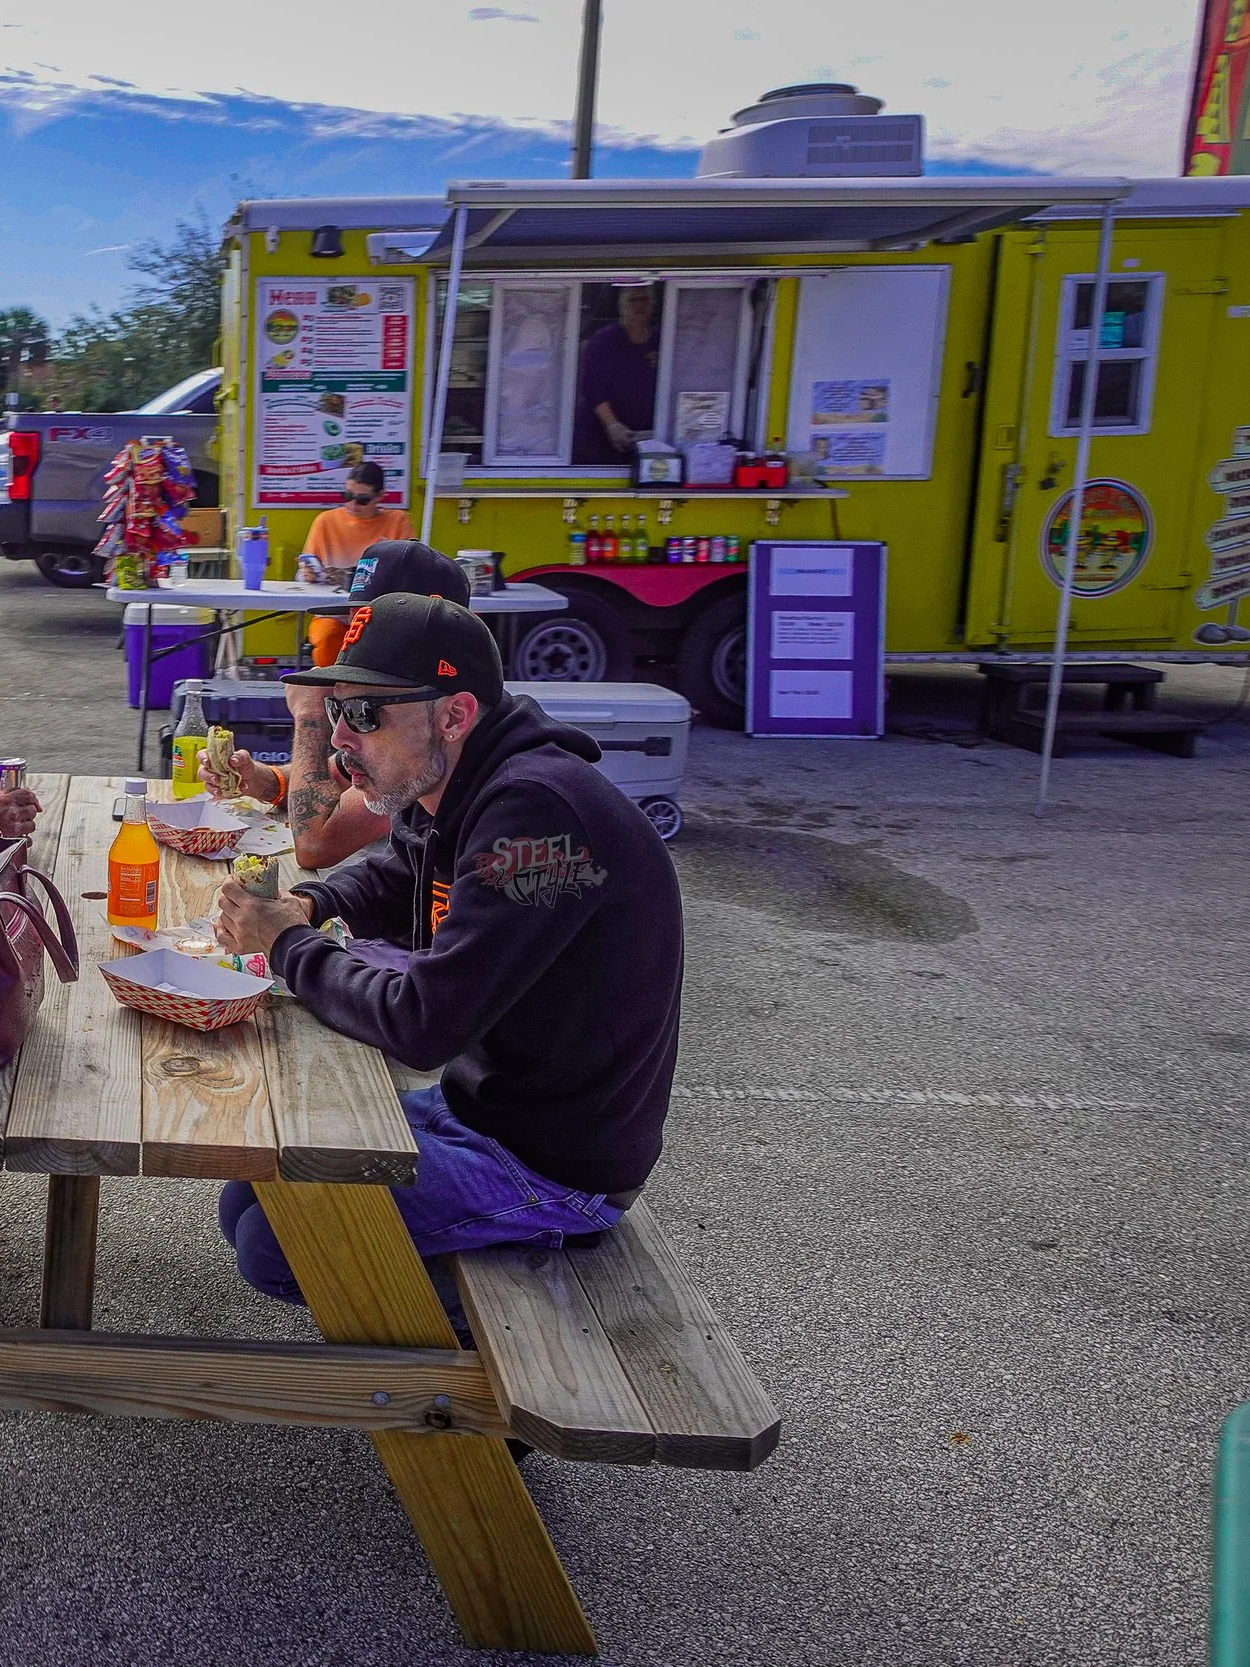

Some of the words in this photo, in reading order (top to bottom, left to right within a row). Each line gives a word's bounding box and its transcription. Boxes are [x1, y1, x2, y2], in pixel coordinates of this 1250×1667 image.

[46, 426, 113, 443] FX4
[252, 751, 292, 762] IGLO
[492, 833, 585, 873] STEEL
